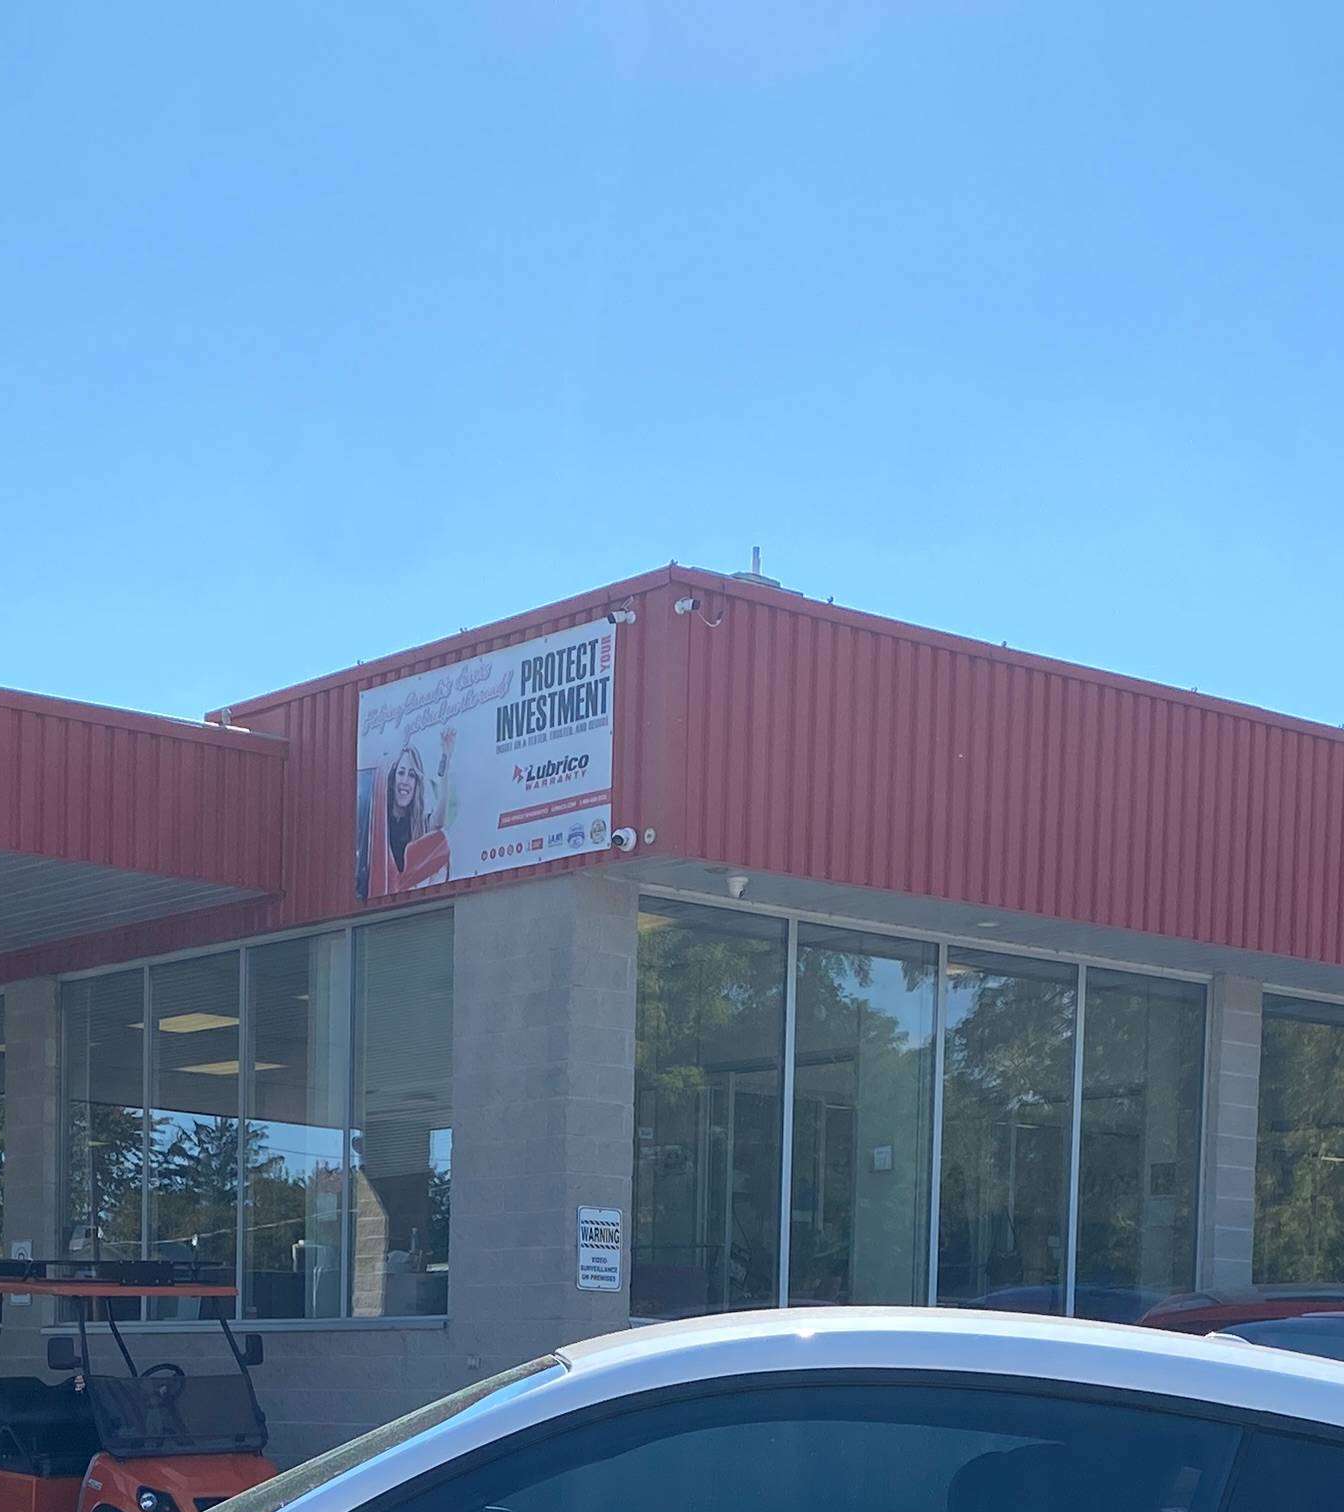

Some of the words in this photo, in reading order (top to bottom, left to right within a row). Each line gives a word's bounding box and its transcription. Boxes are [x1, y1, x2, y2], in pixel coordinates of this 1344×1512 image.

[520, 638, 599, 697] PROTECT
[600, 634, 612, 673] YOUR
[496, 676, 610, 743] INVESTMENT
[525, 769, 587, 791] WARRANTY
[526, 753, 589, 782] Lubrico
[581, 1227, 620, 1244] WARNING
